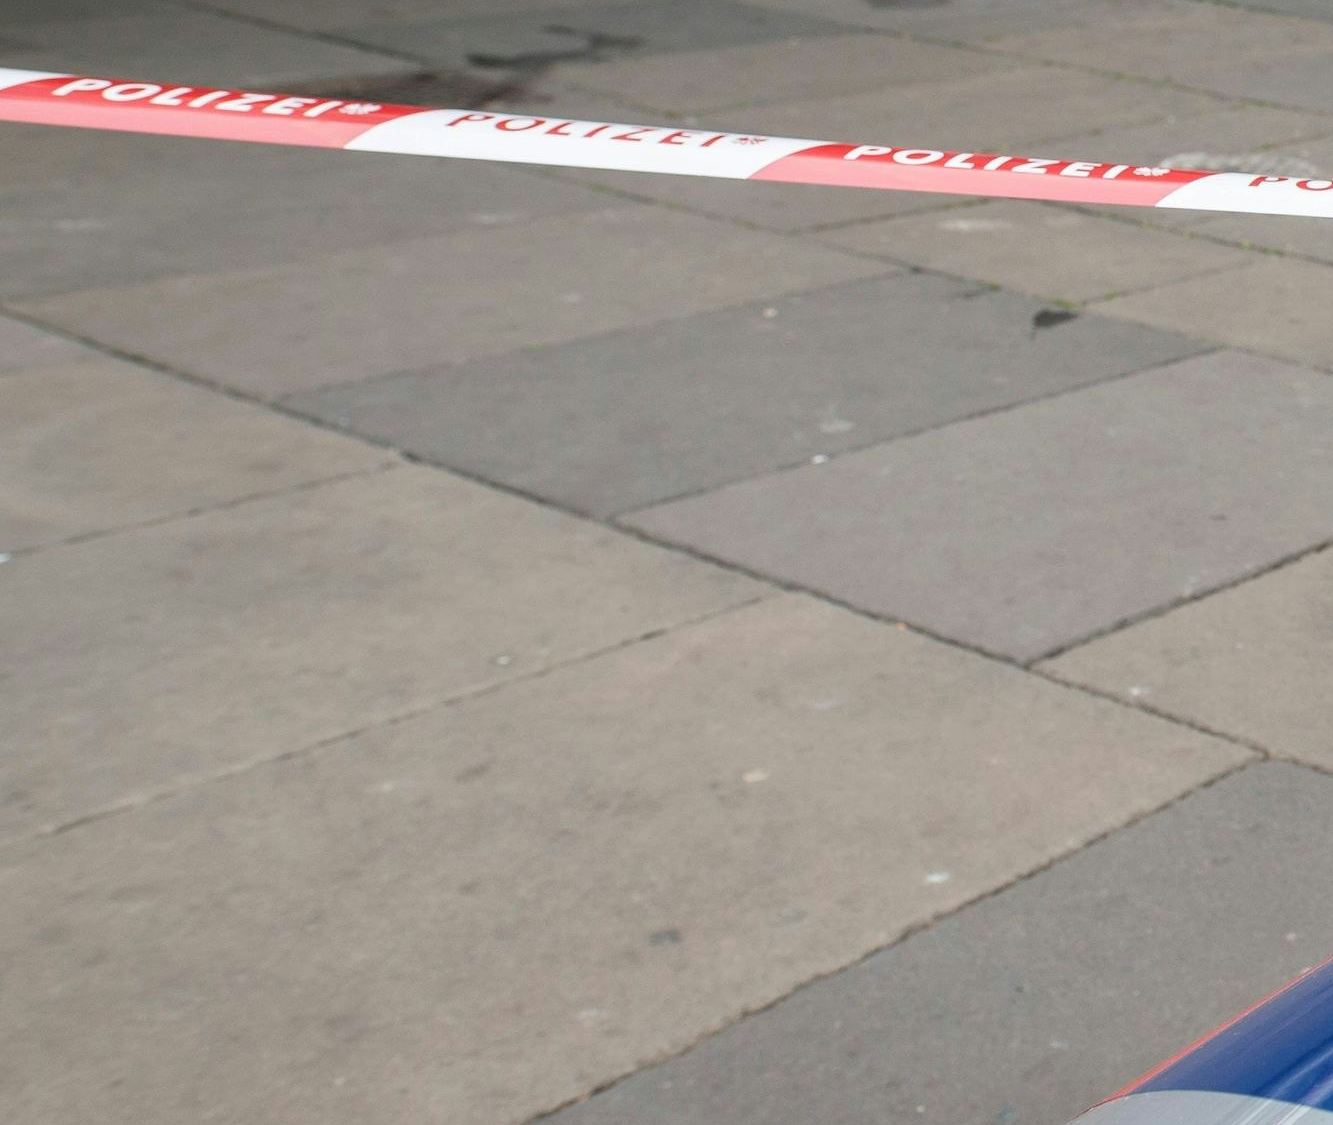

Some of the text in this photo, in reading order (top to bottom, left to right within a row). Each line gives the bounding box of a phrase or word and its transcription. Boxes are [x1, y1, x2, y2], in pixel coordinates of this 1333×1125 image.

[51, 78, 343, 117] POLIZEI
[446, 114, 727, 147] POLIZEI
[843, 144, 1129, 179] POLIZEI
